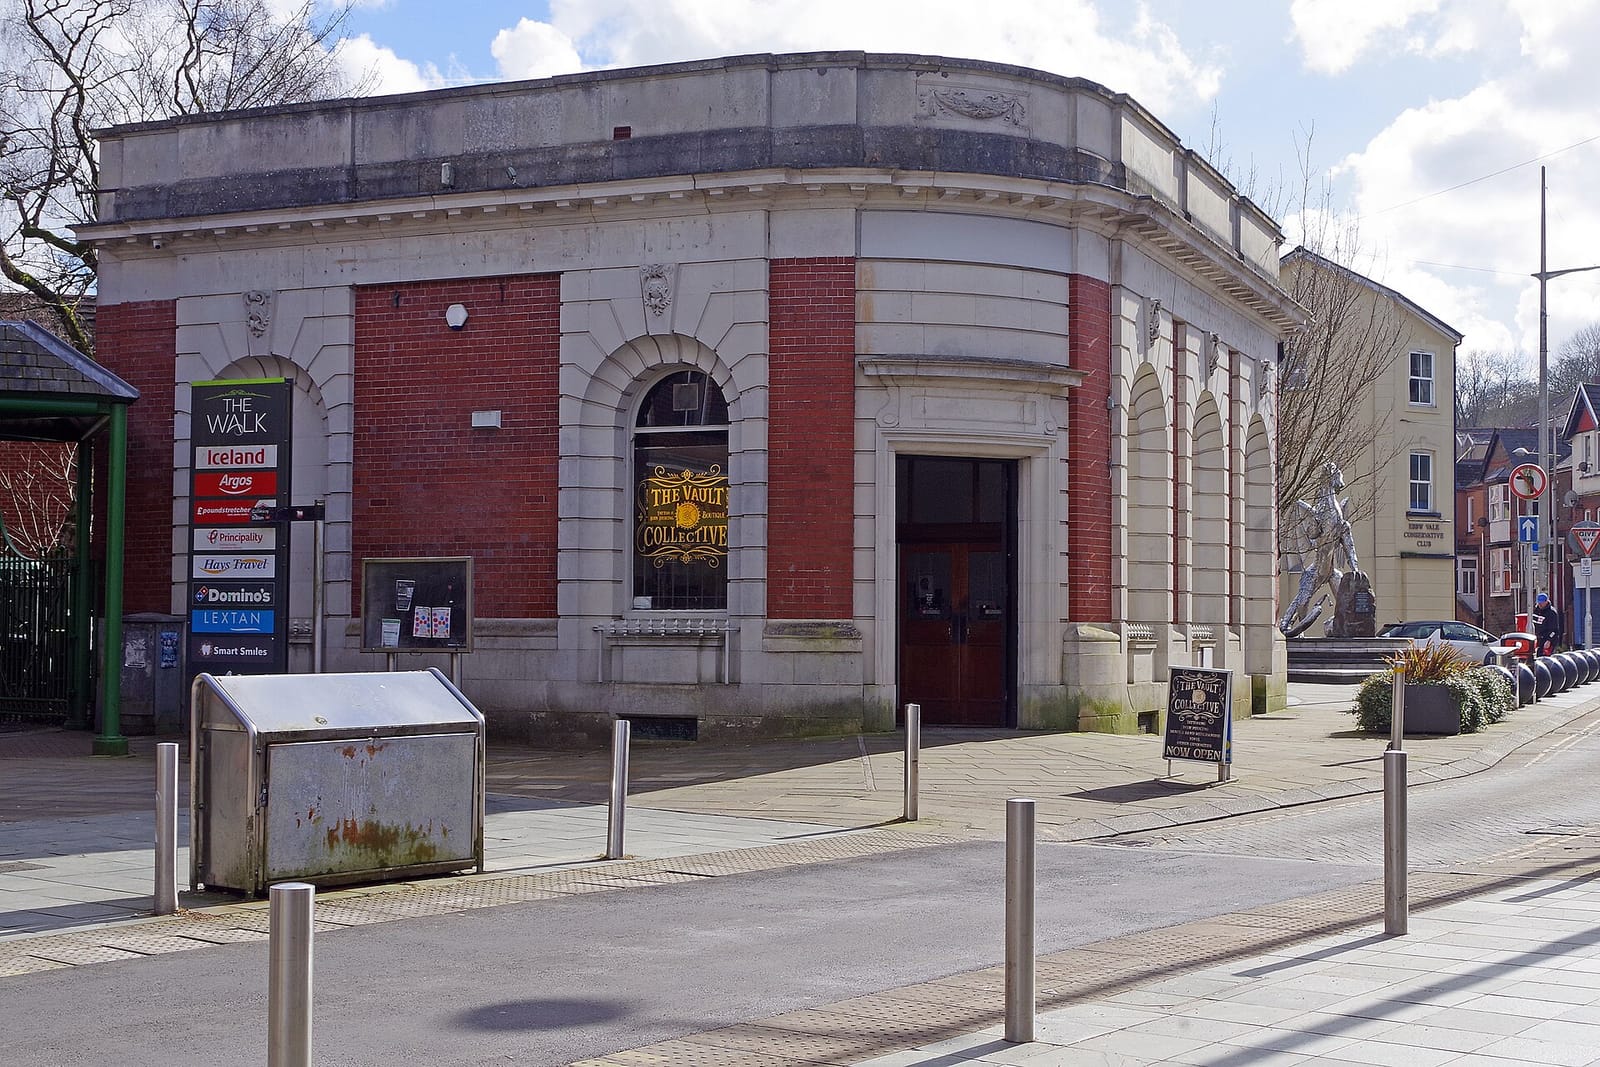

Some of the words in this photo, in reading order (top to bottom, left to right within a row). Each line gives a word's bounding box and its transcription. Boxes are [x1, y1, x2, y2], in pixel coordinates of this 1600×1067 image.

[222, 397, 252, 413] THE
[206, 412, 267, 436] WALK
[207, 448, 265, 465] Iceland
[219, 474, 253, 489] Argos
[650, 488, 680, 507] THE
[681, 485, 725, 506] VAULT
[219, 531, 263, 544] Principality
[643, 525, 728, 547] COLLECTIVE
[1403, 531, 1444, 539] CONSERVATIVE
[204, 559, 231, 570] Hays
[233, 558, 268, 570] Travel
[208, 588, 271, 603] Domino's
[204, 612, 261, 624] LEXTAN
[213, 646, 238, 656] Smart
[240, 647, 268, 656] Smiles
[1180, 681, 1196, 691] THE
[1196, 681, 1219, 694] VAULT
[1174, 698, 1220, 714] COLLECTIVE
[1166, 745, 1191, 758] NOW
[1193, 748, 1221, 760] OPEN
